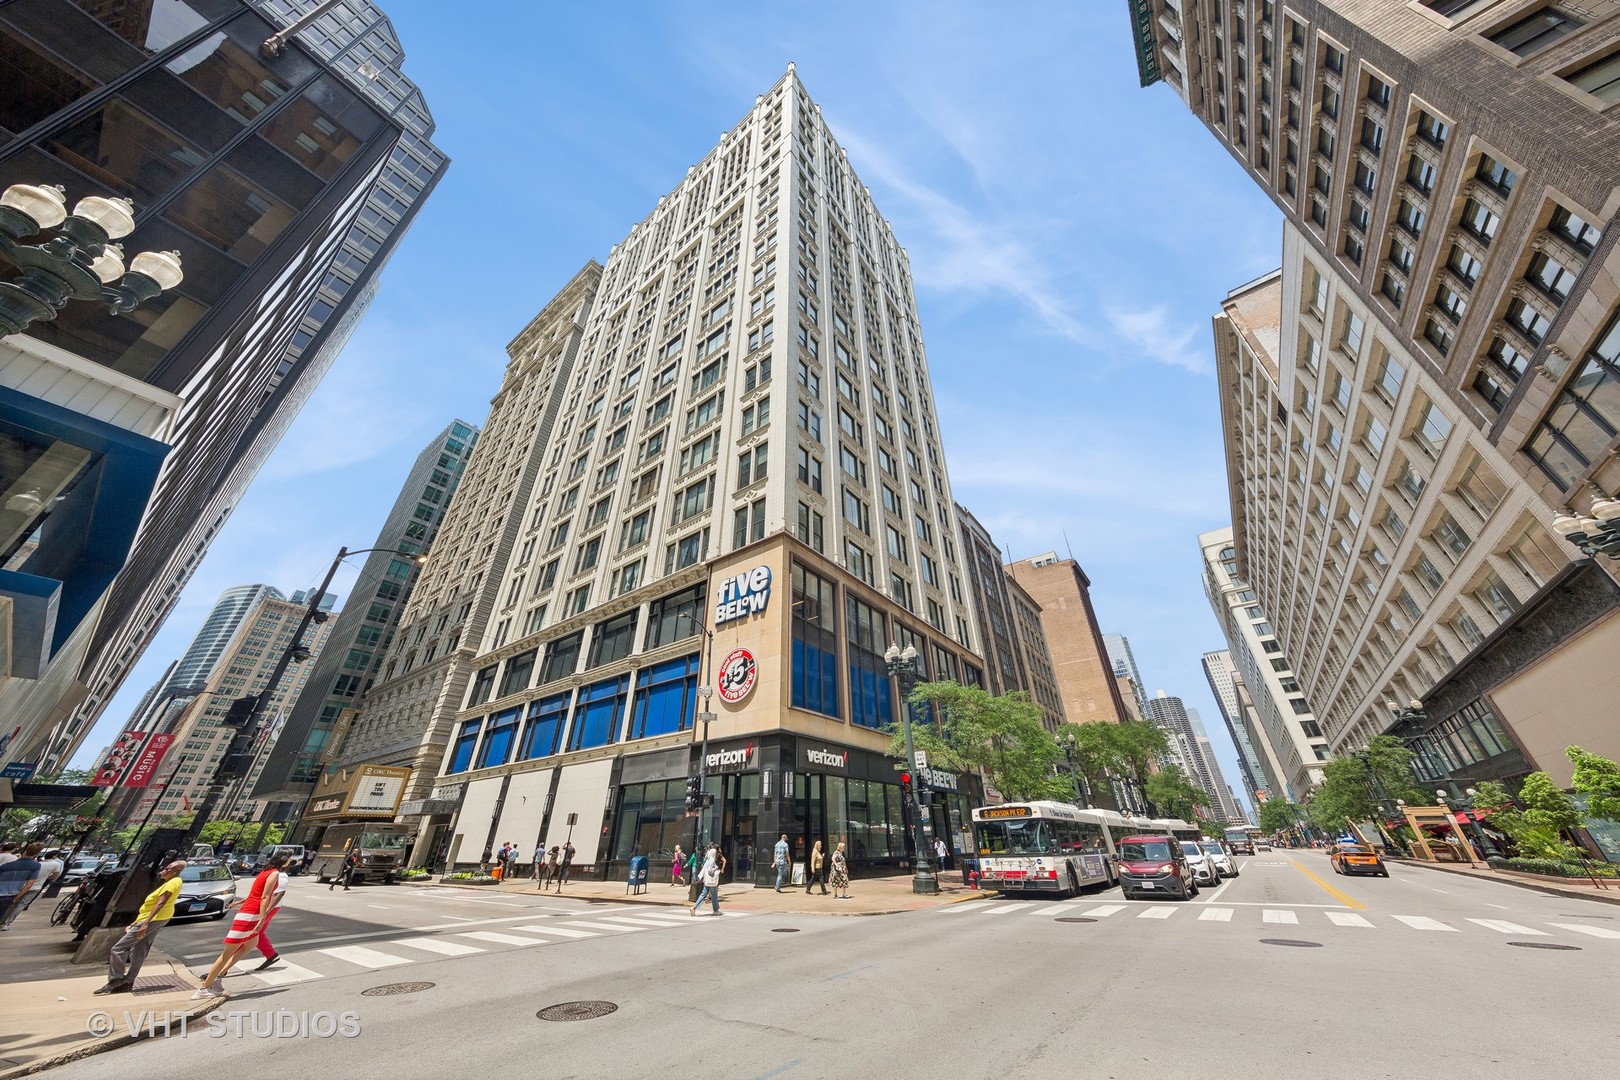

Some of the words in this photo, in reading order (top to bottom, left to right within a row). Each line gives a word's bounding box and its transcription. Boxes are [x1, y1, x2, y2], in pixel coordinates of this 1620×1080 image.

[718, 565, 772, 604] five
[715, 588, 771, 625] BELOW
[133, 751, 157, 781] MUSIC
[706, 748, 747, 767] verizon
[807, 749, 844, 767] verizon
[984, 810, 988, 818] 6
